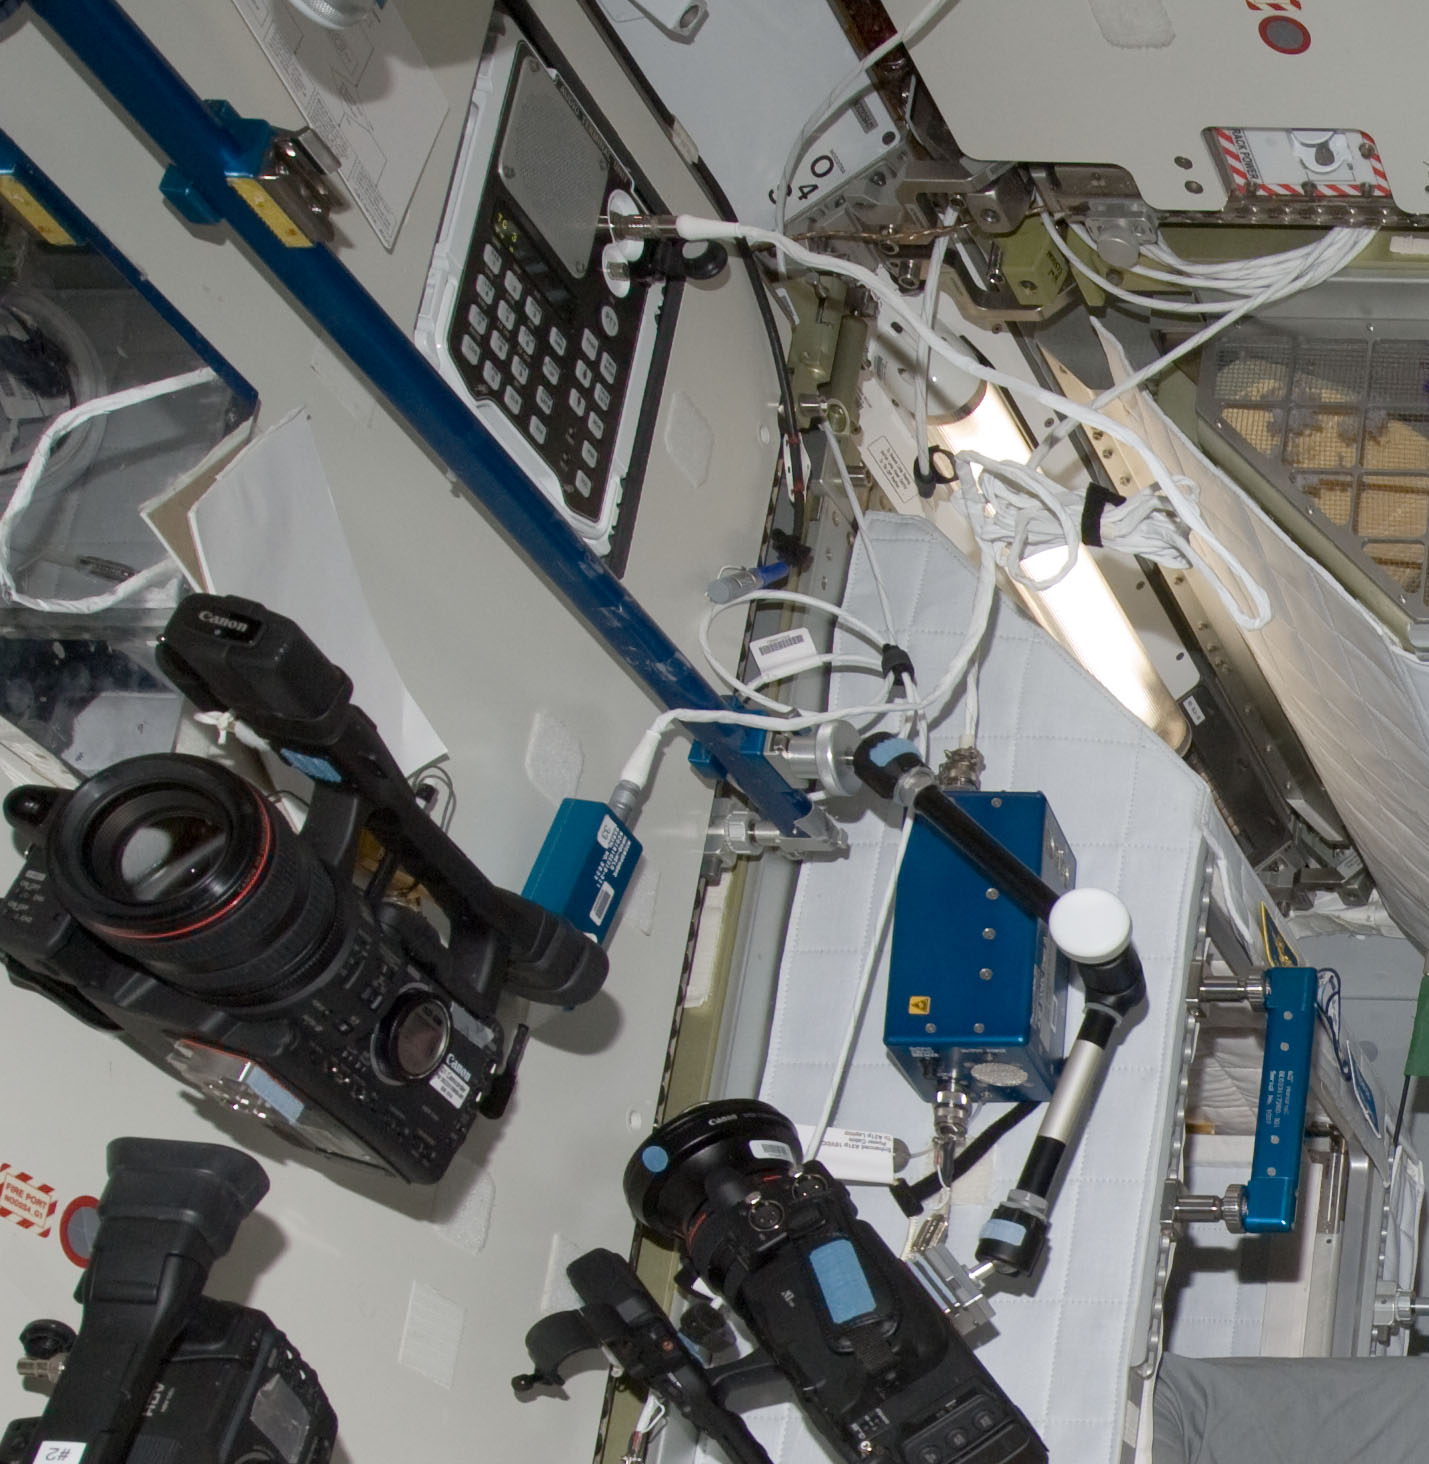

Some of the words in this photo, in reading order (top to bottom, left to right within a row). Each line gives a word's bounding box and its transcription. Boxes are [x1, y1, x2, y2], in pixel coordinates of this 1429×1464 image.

[1241, 152, 1260, 180] POWER
[197, 609, 251, 637] Canon
[445, 1052, 472, 1083] Canon
[5, 1181, 26, 1199] FIRE
[26, 1191, 49, 1210] PORT
[45, 1446, 72, 1462] #2
